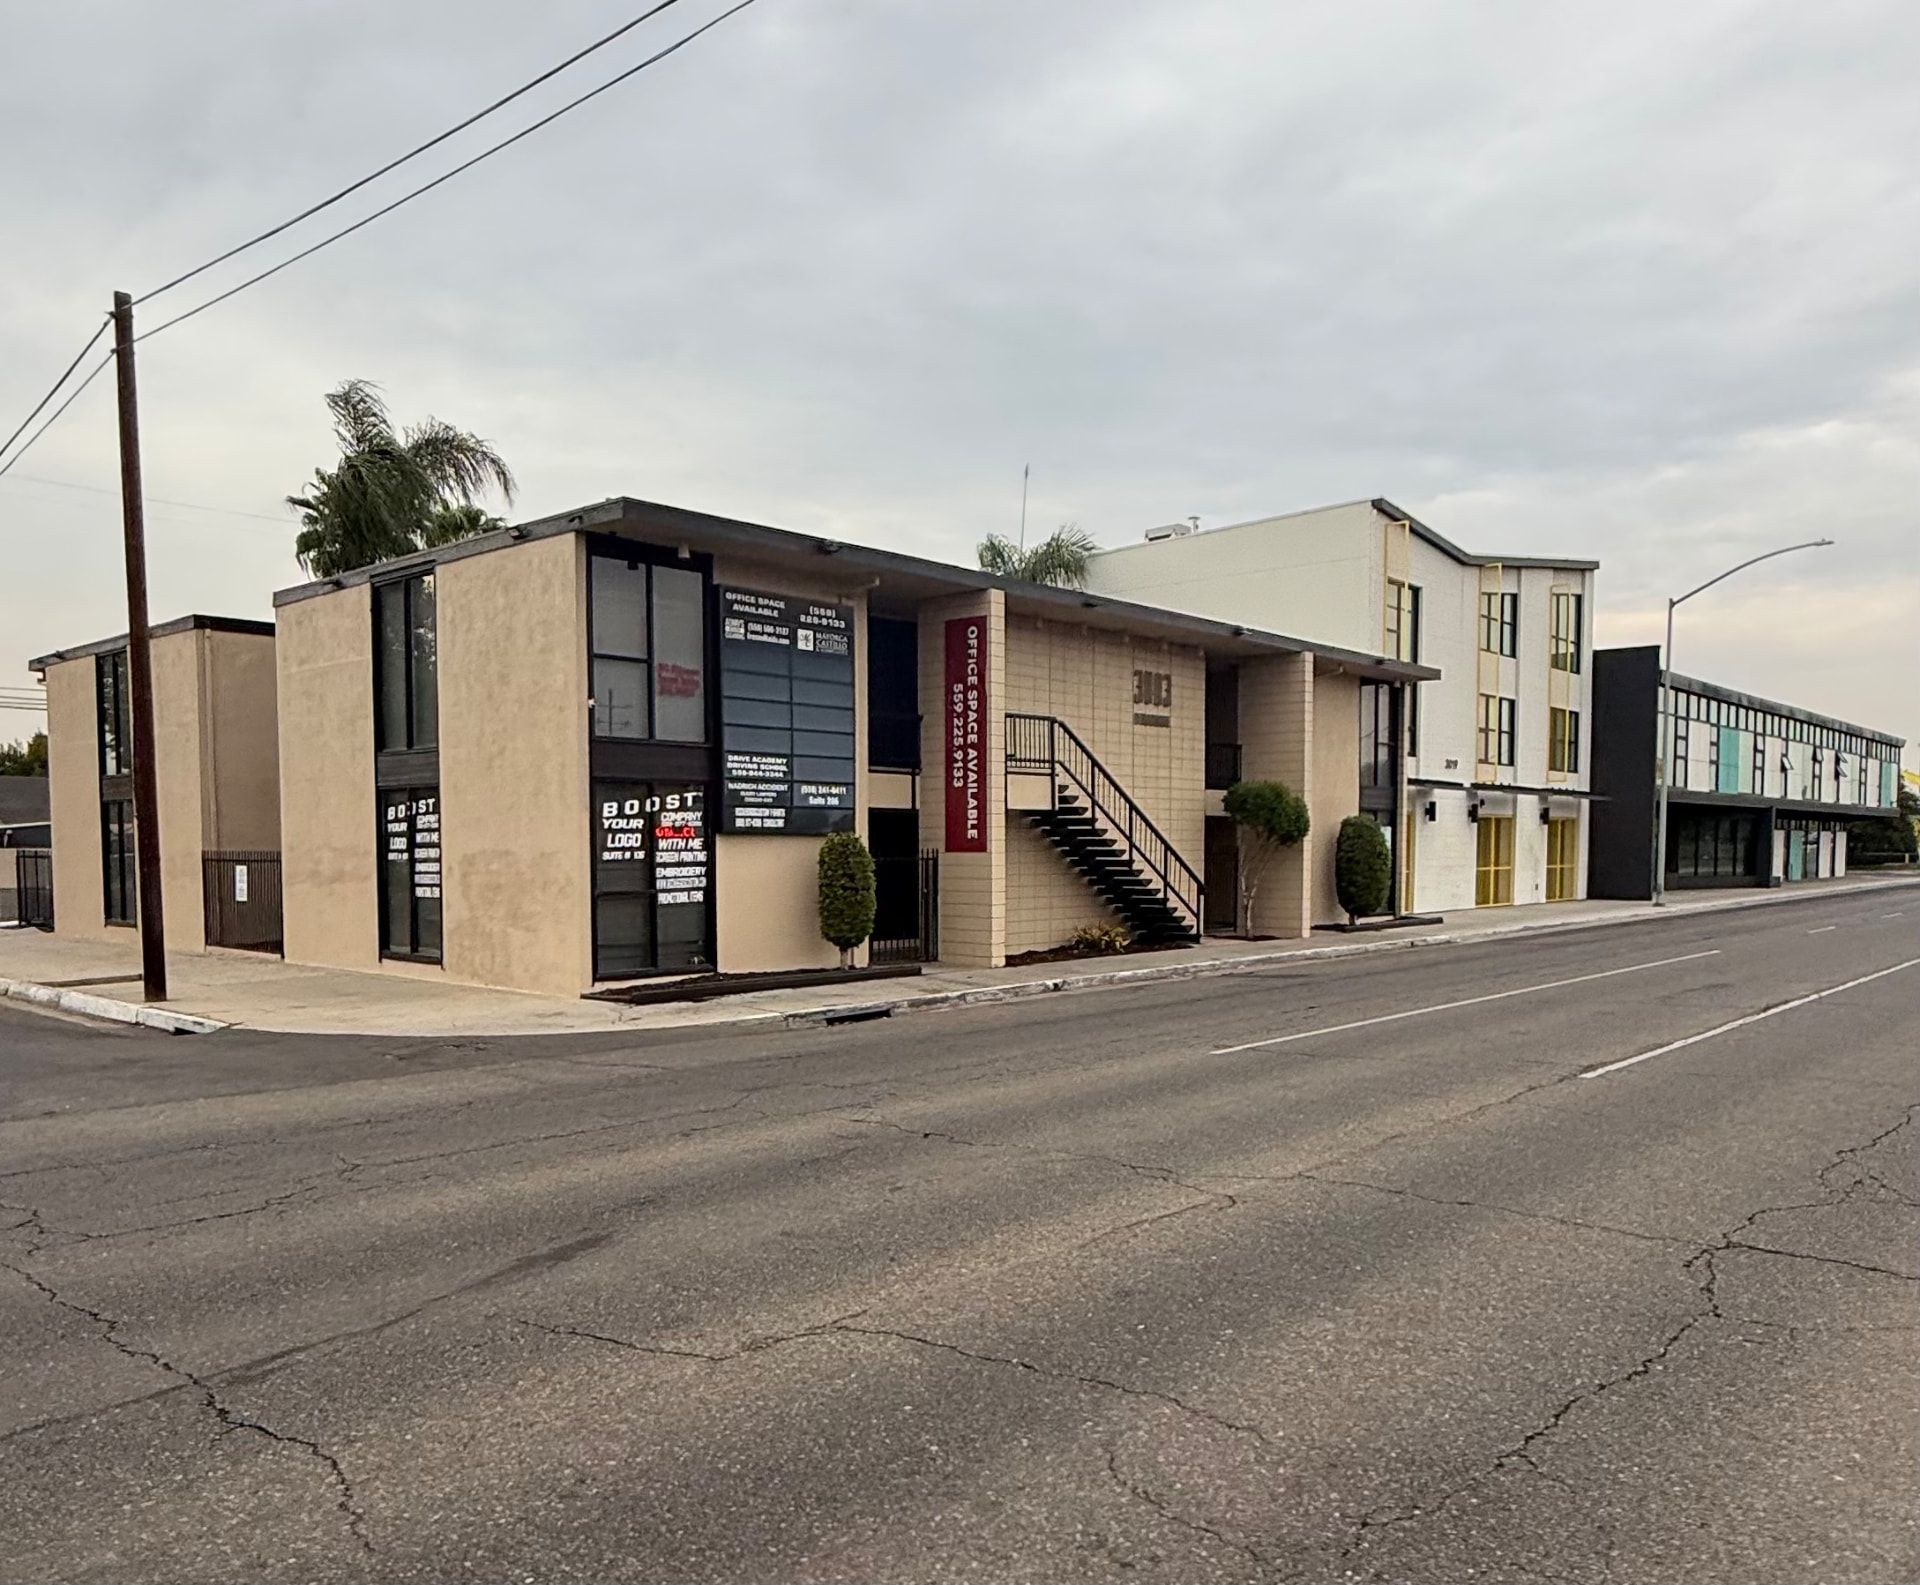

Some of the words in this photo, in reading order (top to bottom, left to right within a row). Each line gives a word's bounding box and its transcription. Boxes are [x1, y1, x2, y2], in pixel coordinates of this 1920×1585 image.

[725, 591, 756, 604] OFFICE
[757, 597, 786, 609] SPACE
[732, 603, 779, 618] AVAILABLE
[966, 625, 979, 687] OFFICE
[966, 689, 979, 745] SPACE
[952, 683, 964, 789] 559.225.9133
[726, 761, 758, 769] DRIVING
[759, 763, 789, 772] SCHOOL
[727, 754, 751, 762] DRIVE
[751, 755, 788, 765] ACADEMY
[966, 747, 979, 840] AVAILABLE
[387, 798, 436, 821] BOOST
[602, 792, 698, 818] BOOST
[661, 811, 703, 822] COMPANY
[387, 822, 408, 833] YOUR
[602, 818, 645, 830] YOUR
[389, 836, 408, 850] LOGO
[606, 832, 643, 848] LOGO
[658, 838, 687, 850] WITH
[687, 837, 705, 850] ME
[602, 851, 625, 861] SUITE
[655, 866, 708, 878] EMBROIDERY
